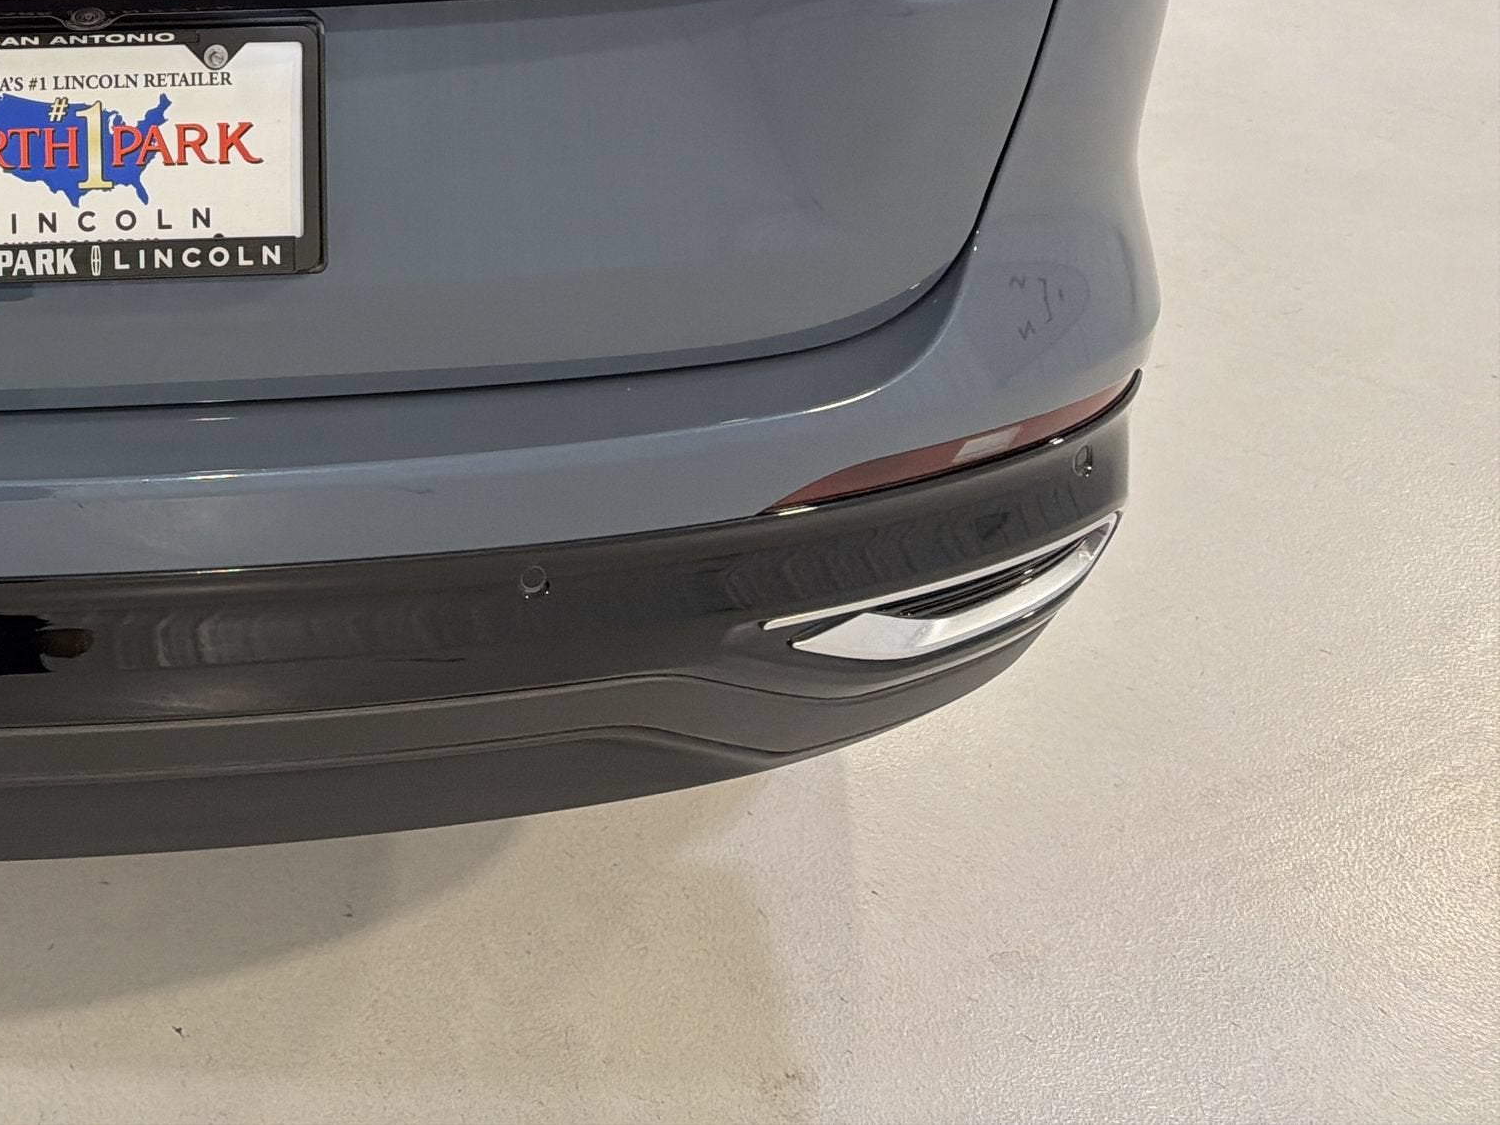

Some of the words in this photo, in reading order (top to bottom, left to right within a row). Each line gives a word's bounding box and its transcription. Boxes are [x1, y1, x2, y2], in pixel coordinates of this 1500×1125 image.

[50, 32, 176, 45] ANTONIO
[28, 77, 48, 91] #1
[53, 74, 140, 91] LINCOLN
[143, 71, 233, 88] RETAILER
[111, 122, 264, 167] PARK
[114, 245, 281, 270] LINCOLN
